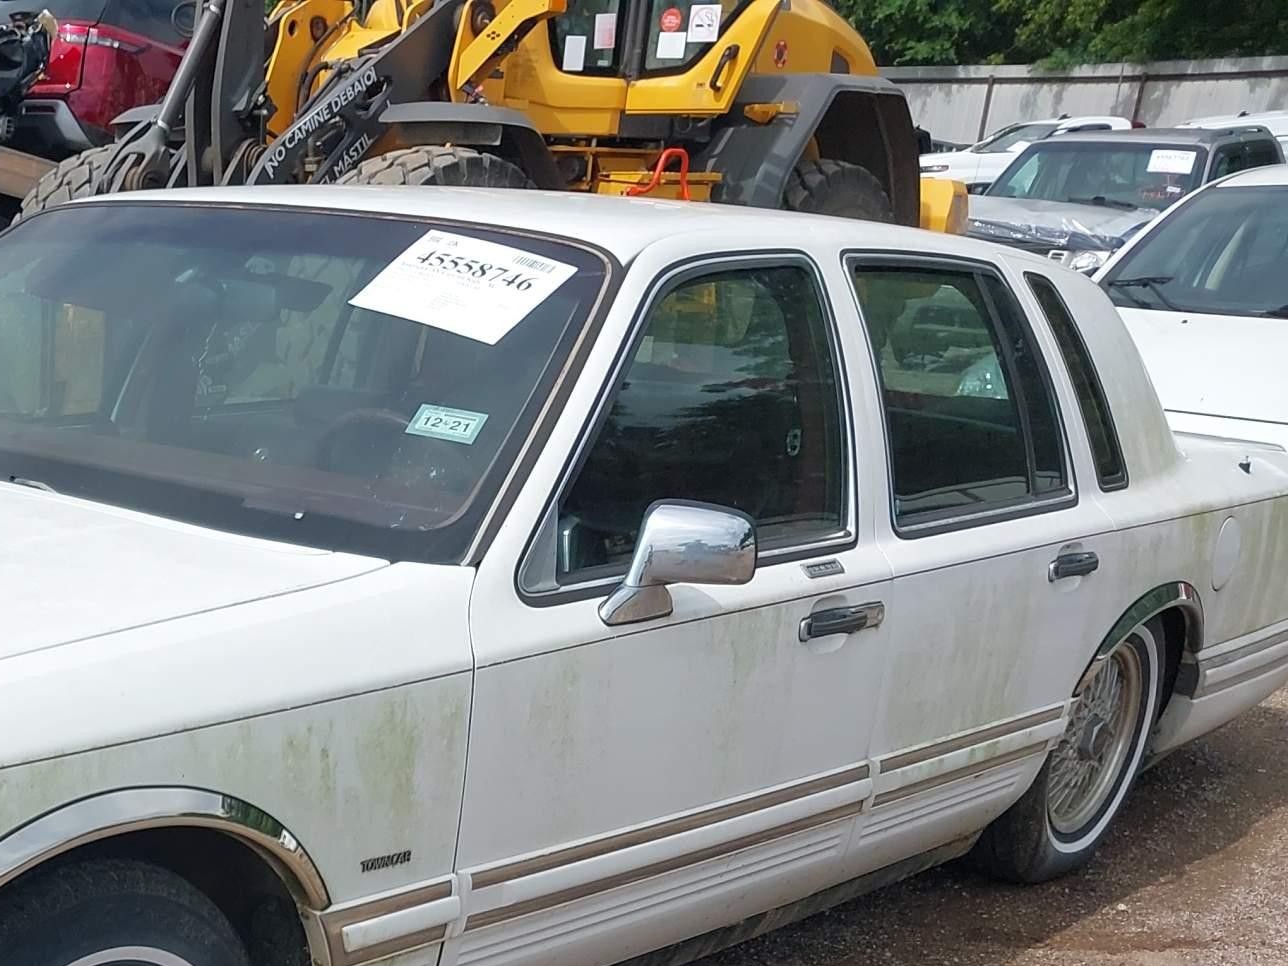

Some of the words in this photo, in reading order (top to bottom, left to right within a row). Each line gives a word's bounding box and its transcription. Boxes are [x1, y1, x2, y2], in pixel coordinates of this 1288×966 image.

[264, 147, 287, 178] NO
[285, 108, 331, 148] CAMINE
[416, 249, 538, 292] 45558746
[423, 416, 443, 428] 12
[449, 420, 471, 433] 21
